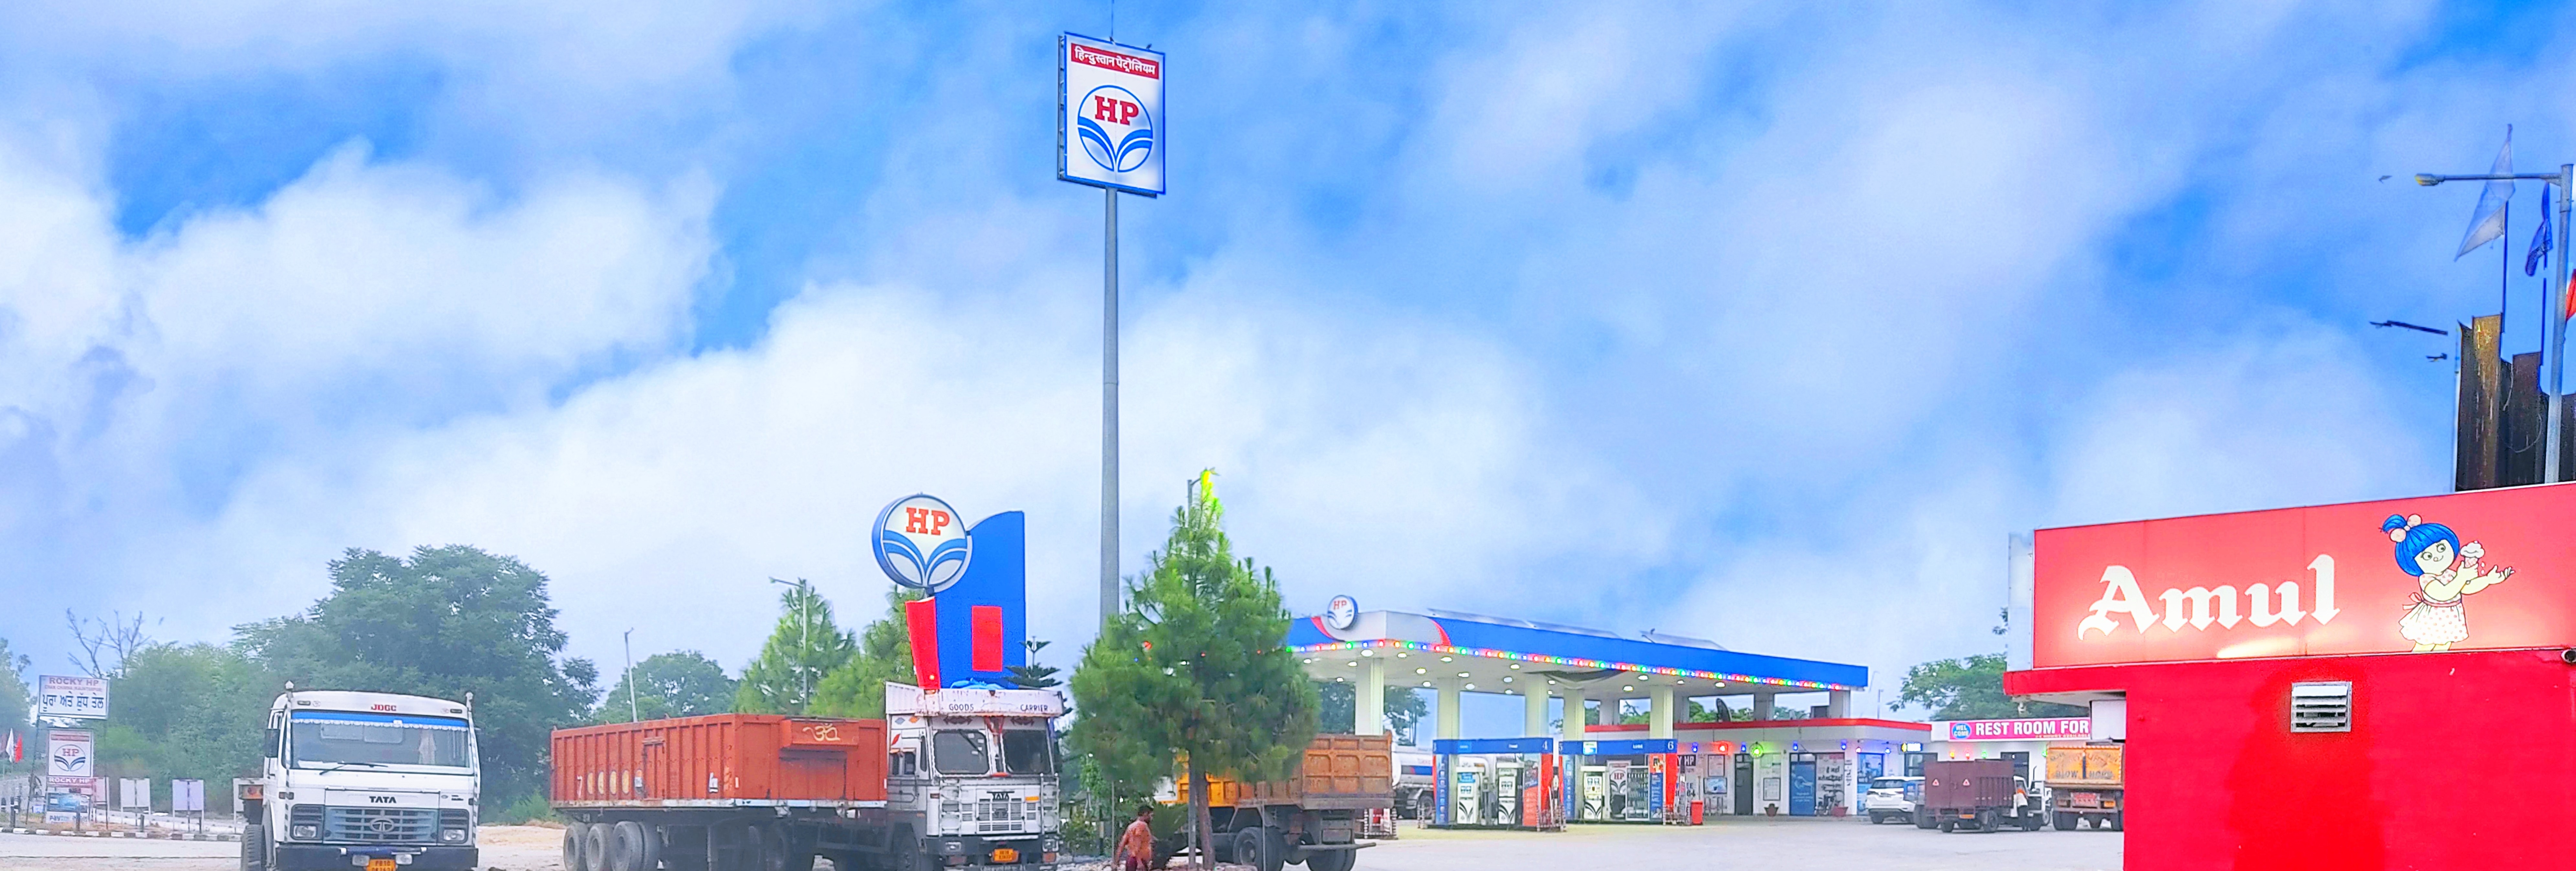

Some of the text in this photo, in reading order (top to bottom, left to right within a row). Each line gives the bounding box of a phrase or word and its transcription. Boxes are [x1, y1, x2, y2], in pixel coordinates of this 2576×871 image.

[1075, 46, 1156, 75] हिन्दुस्तान पेट्रोलियम
[1094, 95, 1139, 125] HP
[906, 507, 950, 536] HP
[2078, 554, 2340, 640] Amul
[1333, 600, 1347, 610] HP
[43, 694, 57, 712] ਪੂਰਾ
[60, 691, 74, 707] ਅਤੇ
[92, 692, 104, 708] ਤੇਲ
[1976, 720, 2089, 735] REST ROOM FOR
[62, 748, 80, 756] HP
[1542, 740, 1548, 750] 4
[1668, 741, 1674, 750] 6
[1684, 755, 1694, 766] HP
